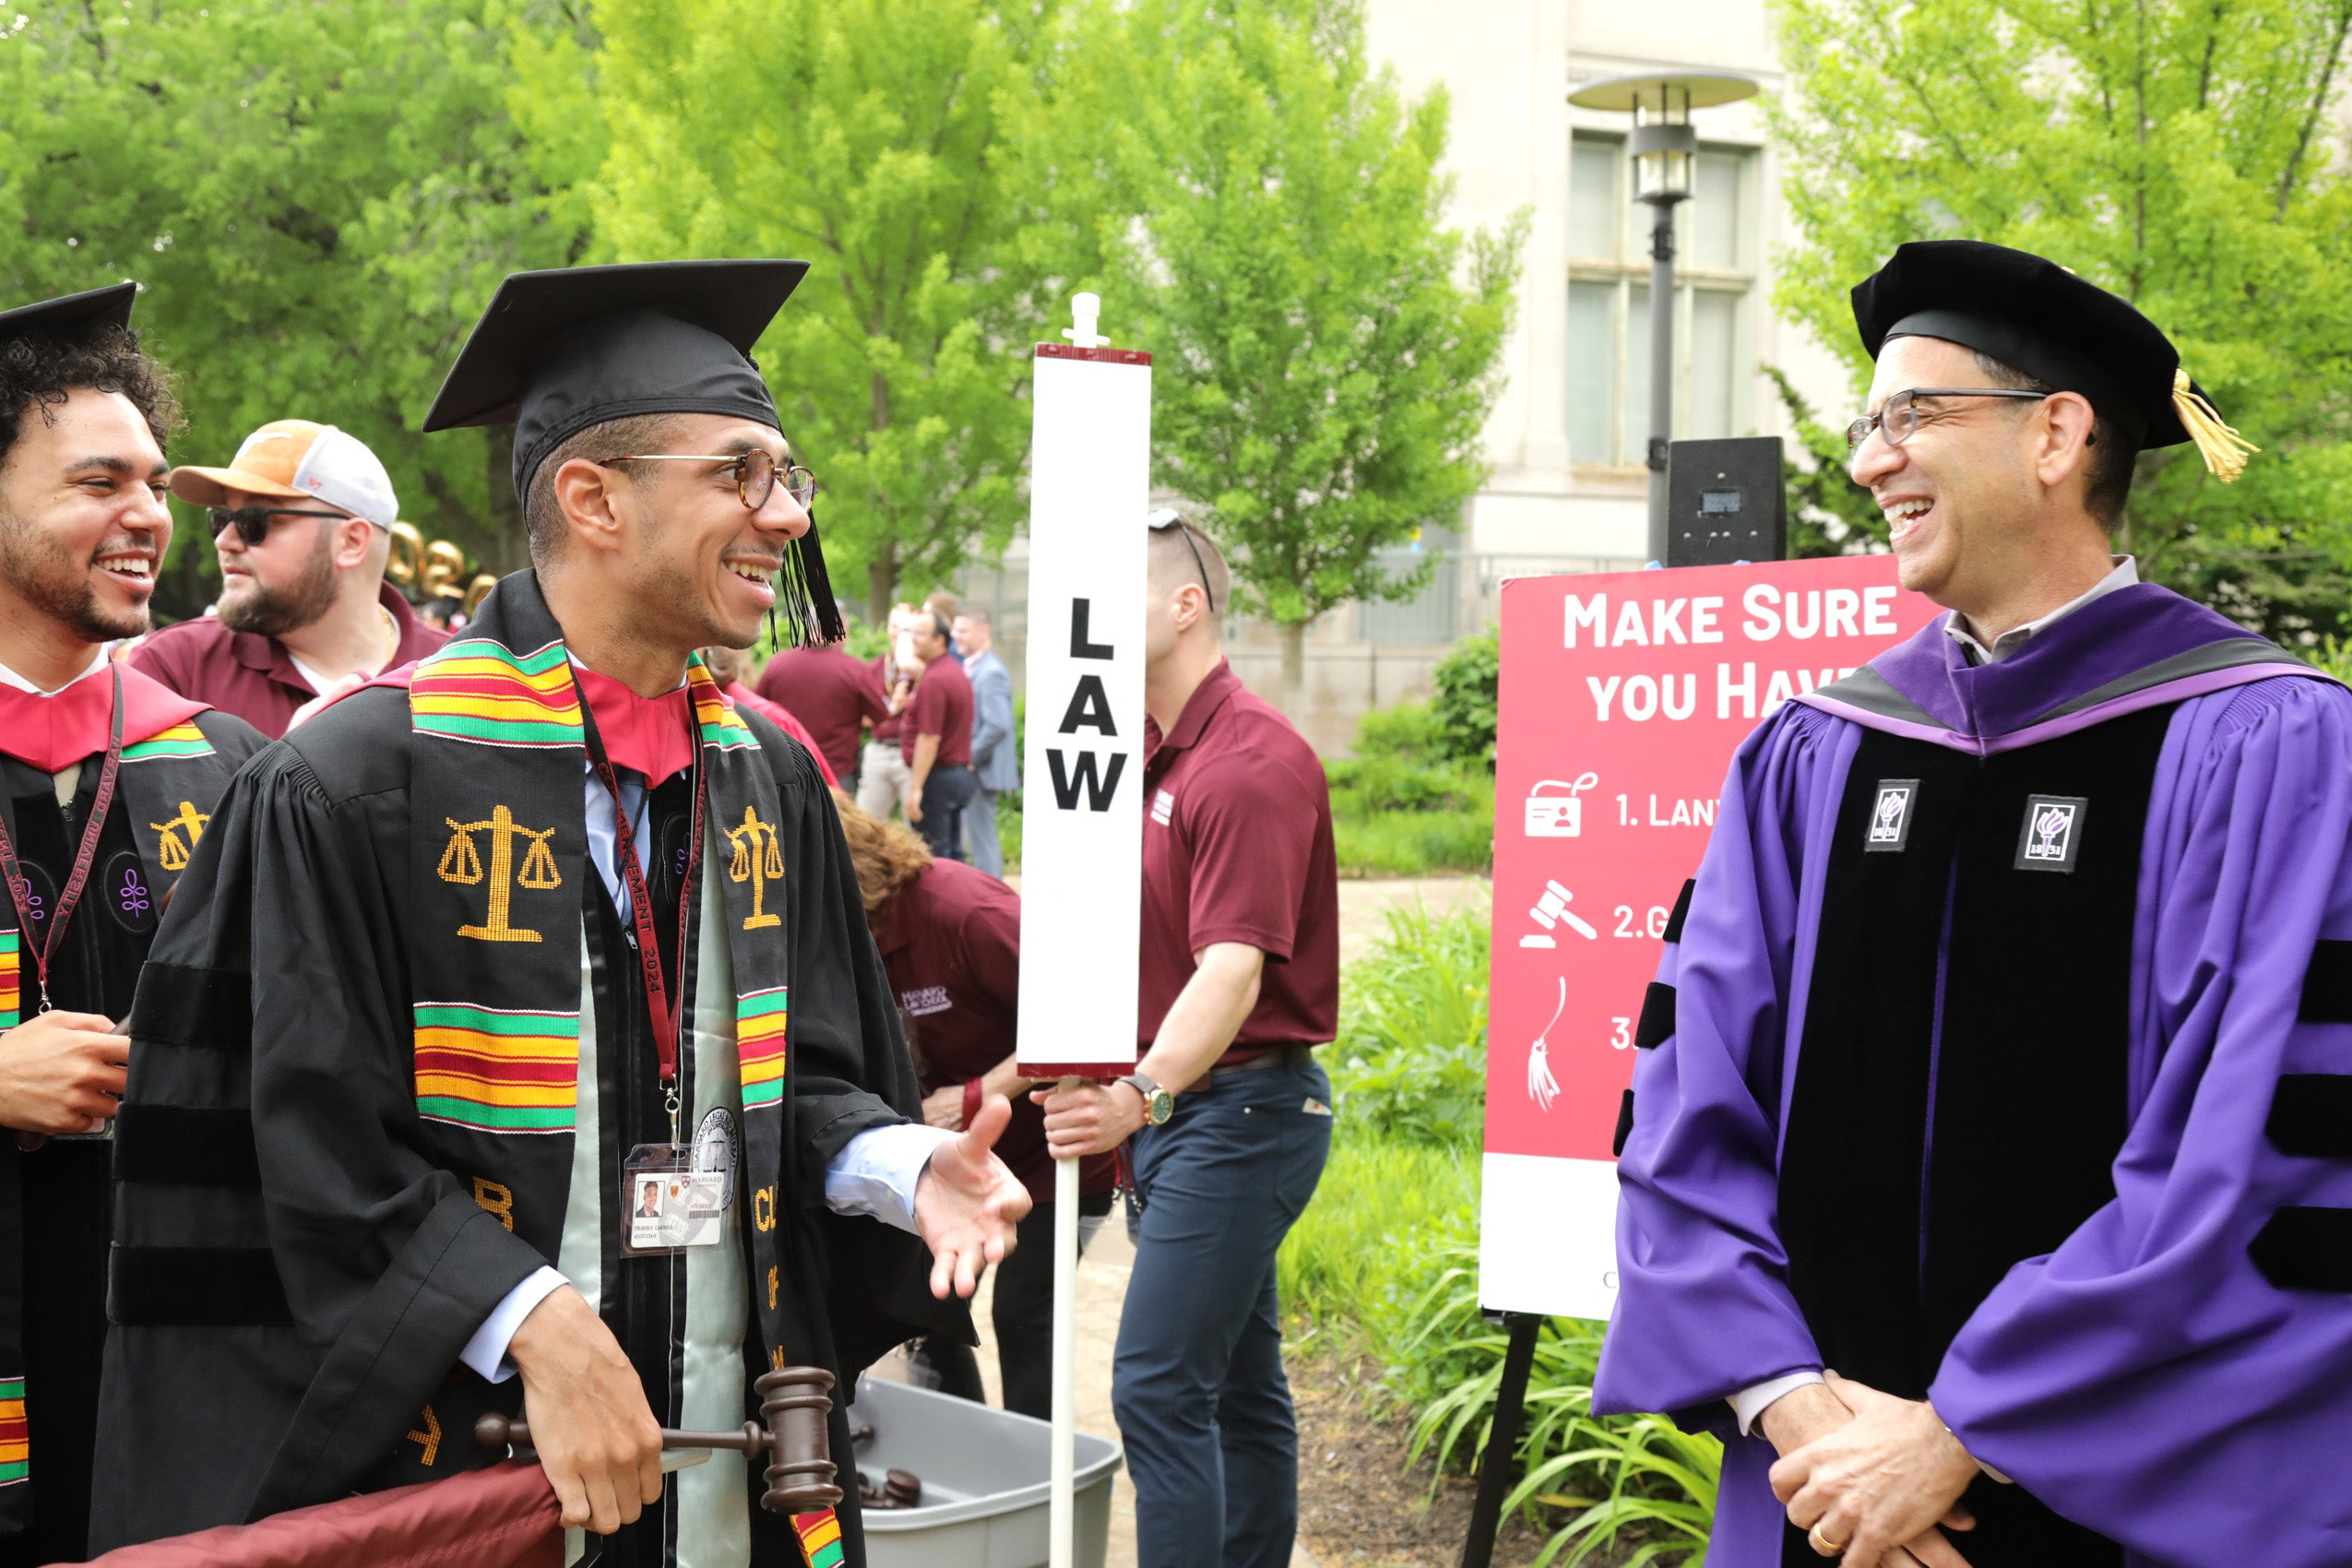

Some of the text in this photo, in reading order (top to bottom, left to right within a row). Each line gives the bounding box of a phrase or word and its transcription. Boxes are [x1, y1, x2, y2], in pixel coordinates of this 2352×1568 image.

[1563, 584, 1897, 648] MAKE SURE
[1046, 598, 1128, 812] LAW
[1586, 662, 1858, 721] YOU HA
[1616, 794, 1720, 826] 1. LAN
[645, 947, 661, 993] 2024
